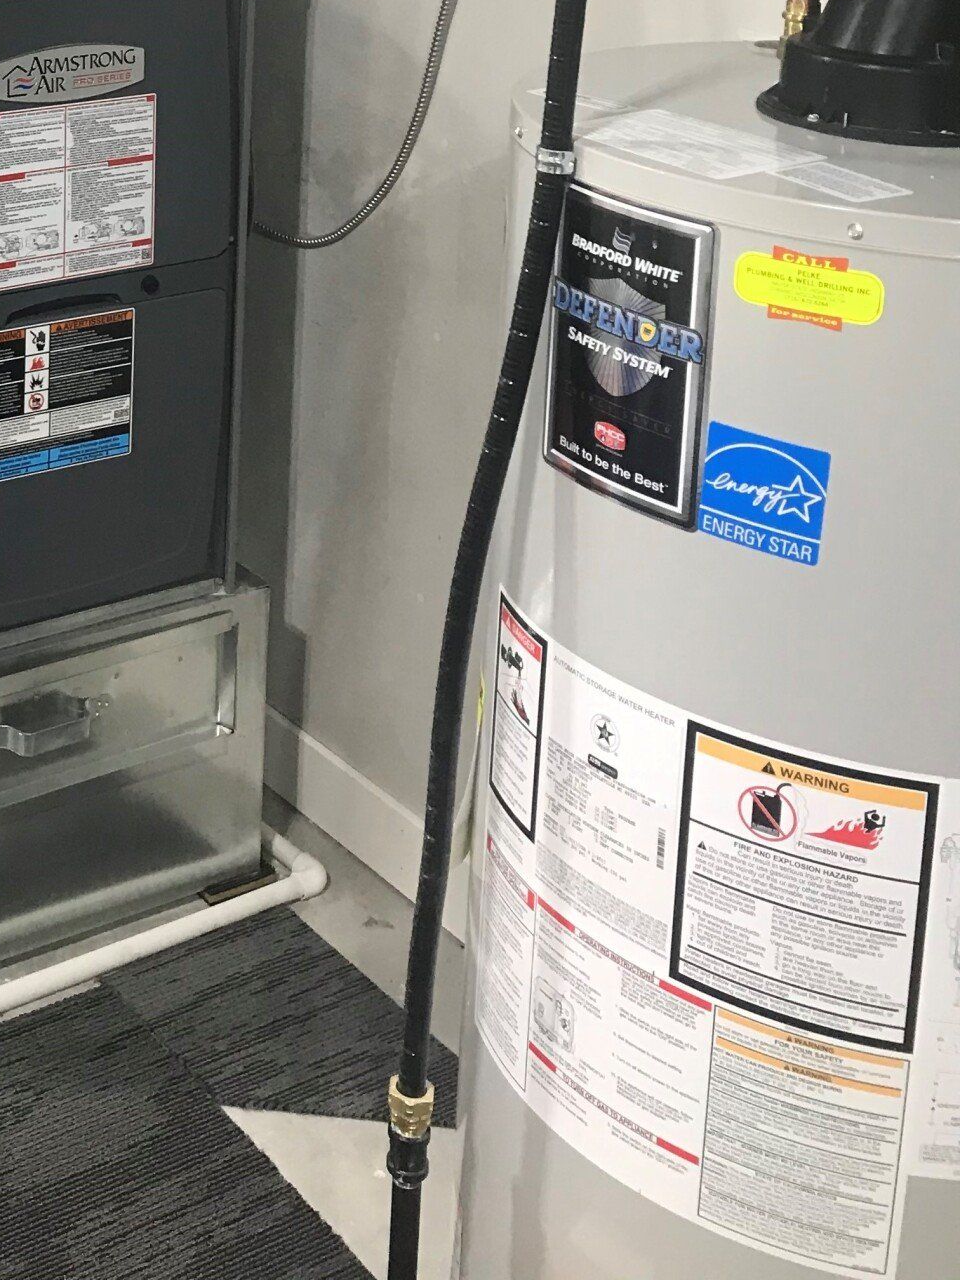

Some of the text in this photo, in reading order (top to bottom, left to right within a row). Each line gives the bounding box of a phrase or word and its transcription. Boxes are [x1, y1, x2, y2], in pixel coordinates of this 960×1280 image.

[27, 48, 136, 76] ARMSTRONG
[34, 72, 132, 95] AIR PRO SERIES
[571, 233, 681, 283] BRADFORD WHITE
[577, 251, 669, 289] CORPORATION
[782, 253, 837, 270] CALL
[746, 267, 785, 281] PLUMBING
[796, 277, 814, 287] WELL
[818, 281, 853, 293] DRILLING
[63, 312, 128, 330] AVERTISSEMENT
[555, 279, 704, 364] DEFENDER
[771, 307, 837, 326] for service
[568, 326, 611, 356] SAFETY
[559, 434, 580, 456] Built
[581, 451, 593, 462] to
[594, 454, 609, 470] be
[611, 462, 631, 480] the
[703, 514, 813, 562] ENERGY STAR
[553, 655, 676, 728] AUTOMATIC STORAGE WATER HEATER
[780, 766, 850, 793] WARNING
[734, 841, 858, 883] FIRE AND EXPLOSION HAZARD
[797, 841, 867, 864] Flammable Vapors
[738, 850, 751, 860] Can
[805, 872, 823, 884] injury
[774, 1039, 844, 1063] FOR YOUR SAFETY
[794, 1038, 834, 1053] WARNING
